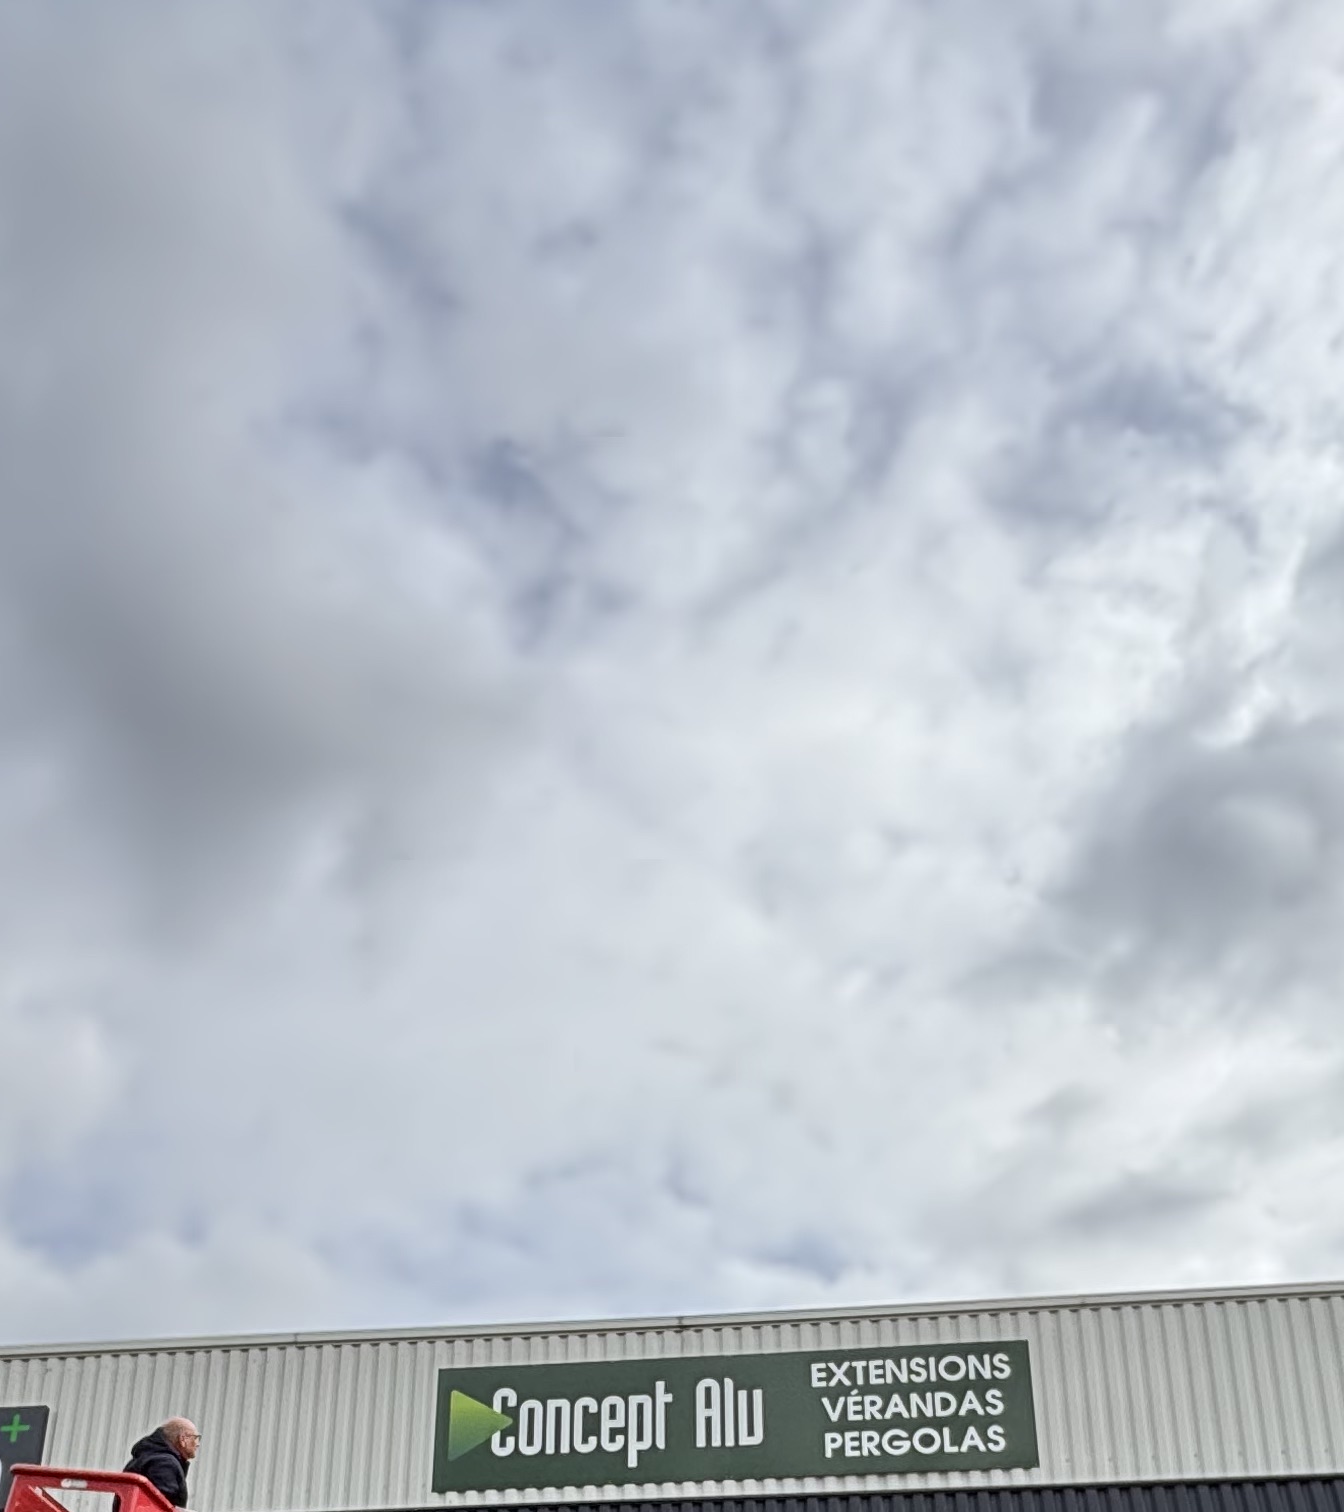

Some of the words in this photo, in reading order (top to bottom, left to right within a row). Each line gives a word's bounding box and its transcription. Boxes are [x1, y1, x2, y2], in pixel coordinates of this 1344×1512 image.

[810, 1353, 1012, 1388] EXTENSIONS
[490, 1380, 673, 1469] Concept
[695, 1377, 764, 1448] Alu
[821, 1388, 1006, 1423] VÉRANDAS
[824, 1424, 1007, 1459] PERGOLAS
